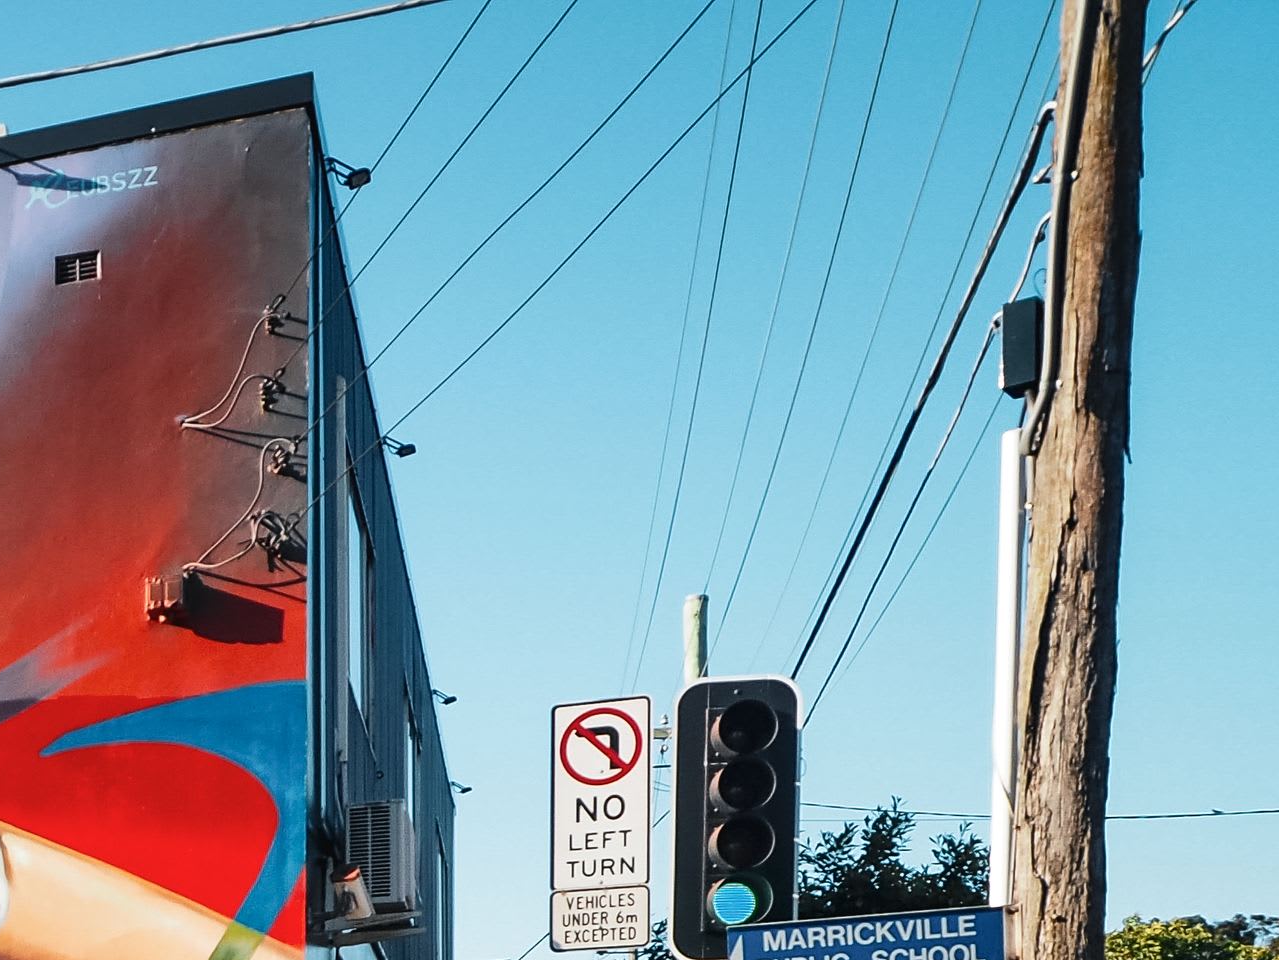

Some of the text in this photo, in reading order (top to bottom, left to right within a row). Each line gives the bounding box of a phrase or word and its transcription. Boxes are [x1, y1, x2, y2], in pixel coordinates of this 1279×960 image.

[575, 794, 626, 823] NO
[569, 829, 632, 851] LEFT
[566, 857, 636, 878] TURN
[566, 893, 635, 910] VEHICLES
[562, 911, 638, 928] UNDER 6m
[564, 926, 637, 944] EXCEPTED
[762, 914, 977, 952] MARRICKVILLE
